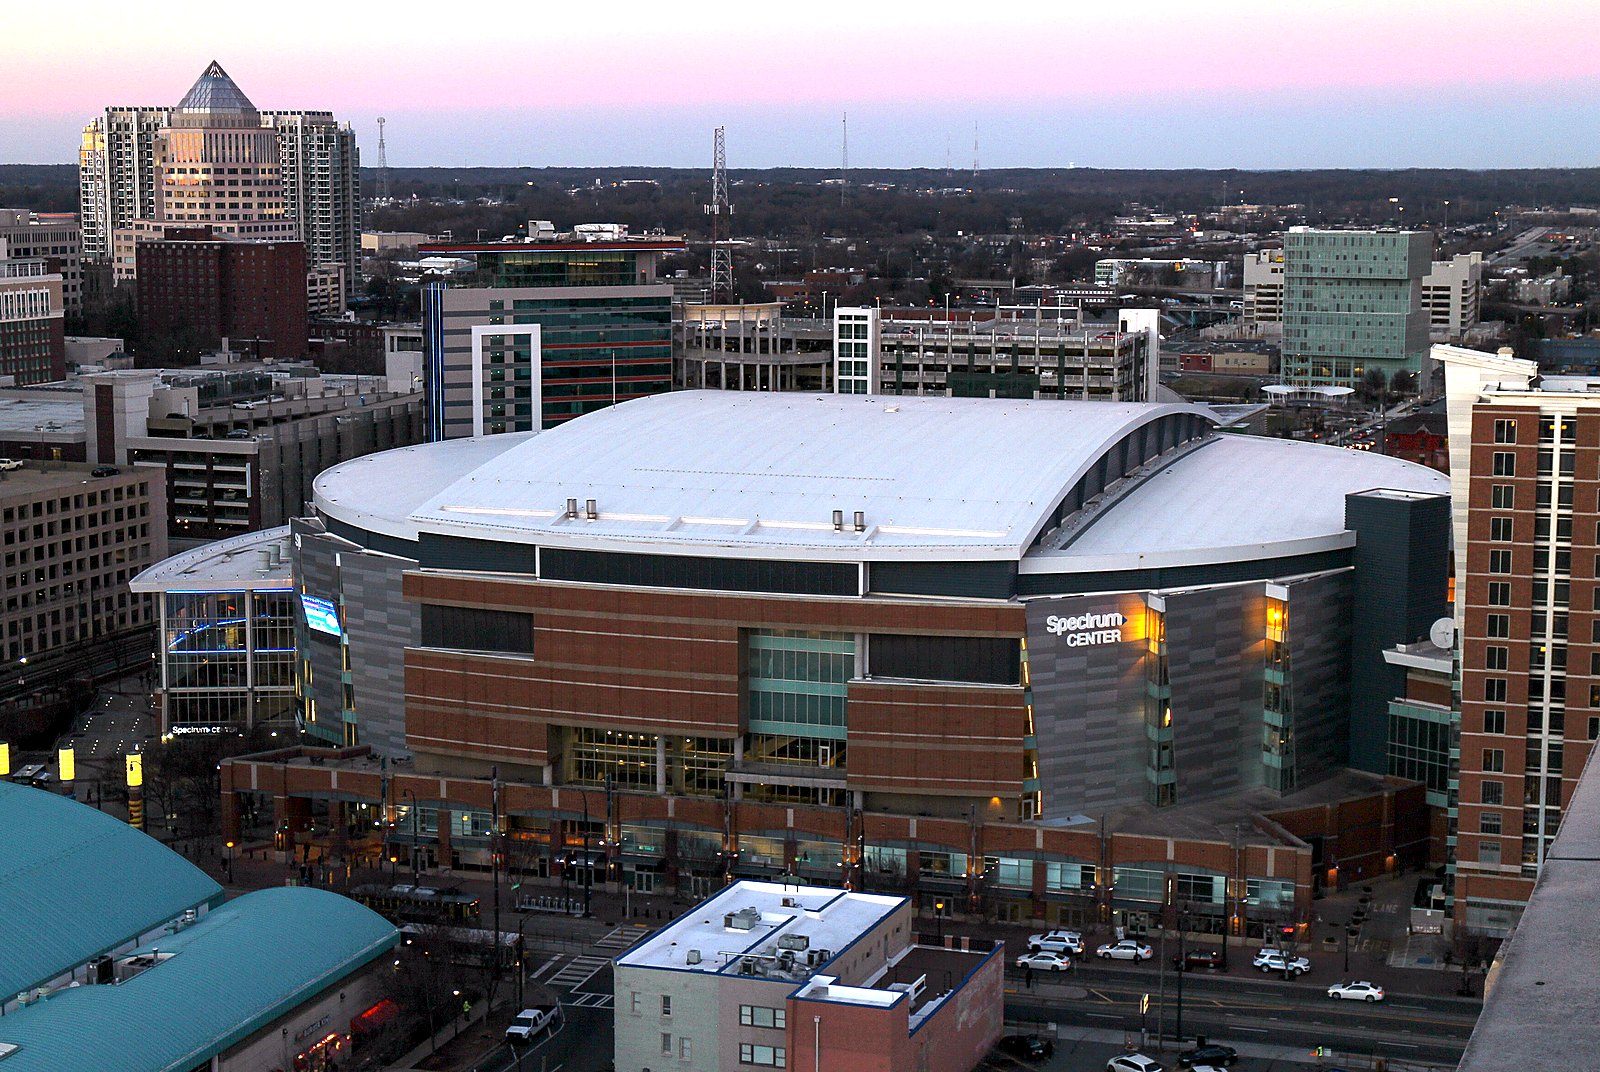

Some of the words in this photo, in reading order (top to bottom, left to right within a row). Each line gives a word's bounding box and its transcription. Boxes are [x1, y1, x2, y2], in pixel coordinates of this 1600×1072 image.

[1046, 612, 1122, 636] Spectrum
[1066, 629, 1122, 647] CENTER
[172, 725, 207, 735] Spectrum
